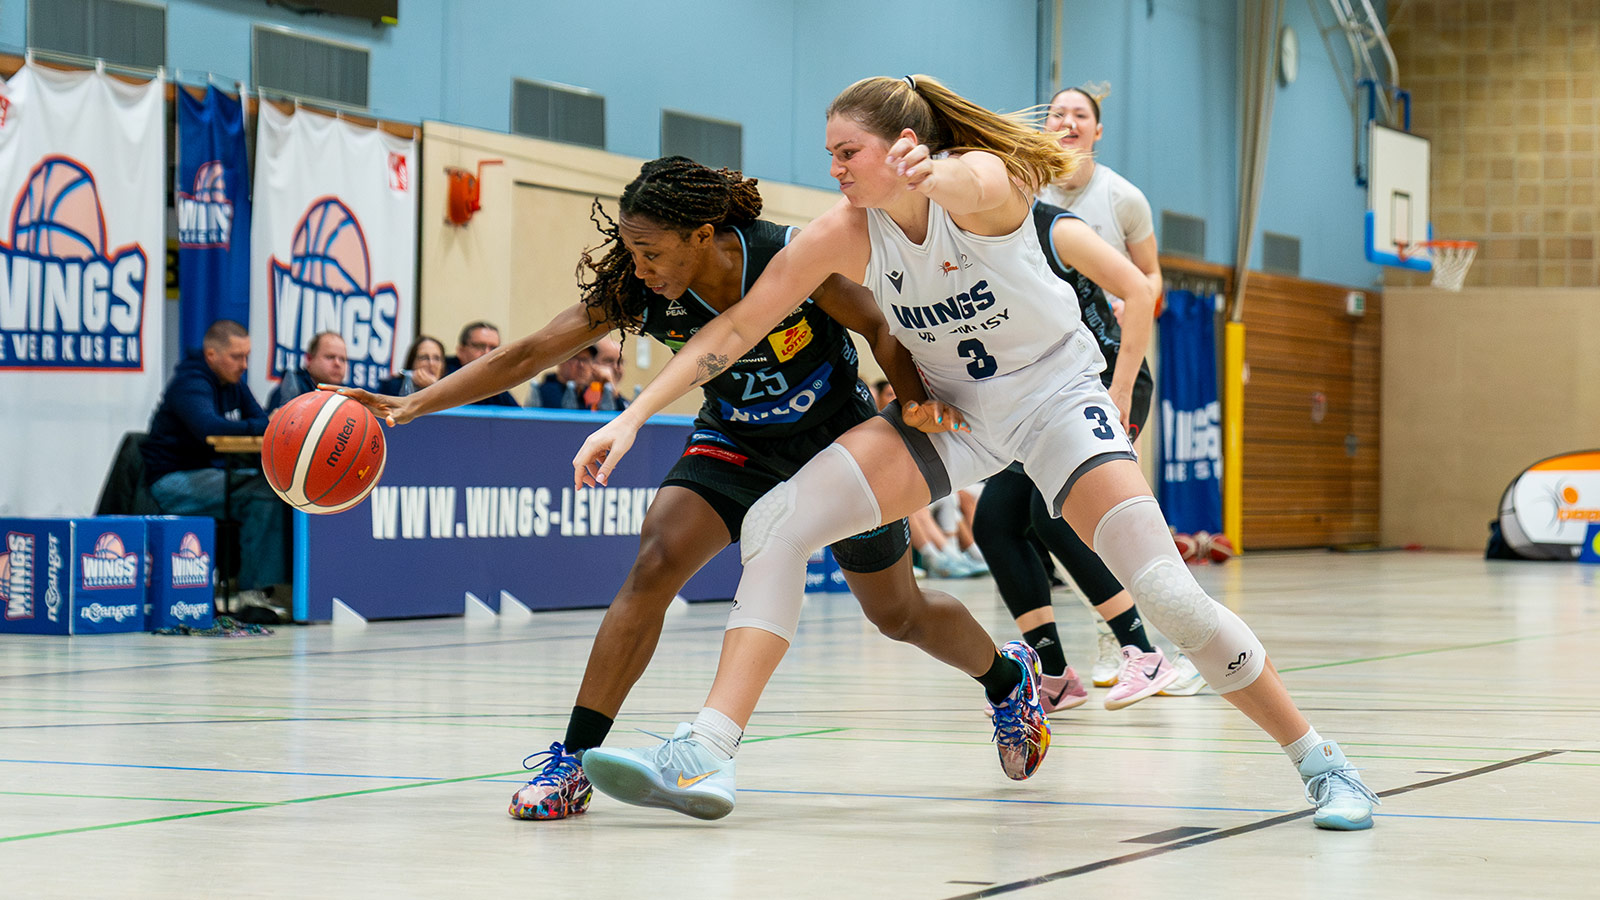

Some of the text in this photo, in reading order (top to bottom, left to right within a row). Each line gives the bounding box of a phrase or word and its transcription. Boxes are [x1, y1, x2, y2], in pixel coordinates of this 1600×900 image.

[274, 268, 397, 365] WINGS
[665, 309, 688, 317] PEAK
[891, 280, 996, 329] WINGS
[781, 330, 808, 356] LOTTO
[957, 338, 998, 379] 3
[731, 367, 789, 401] 25
[1083, 406, 1115, 440] 3
[326, 417, 357, 468] molten
[7, 533, 26, 616] WINGS
[82, 555, 137, 578] WINGS
